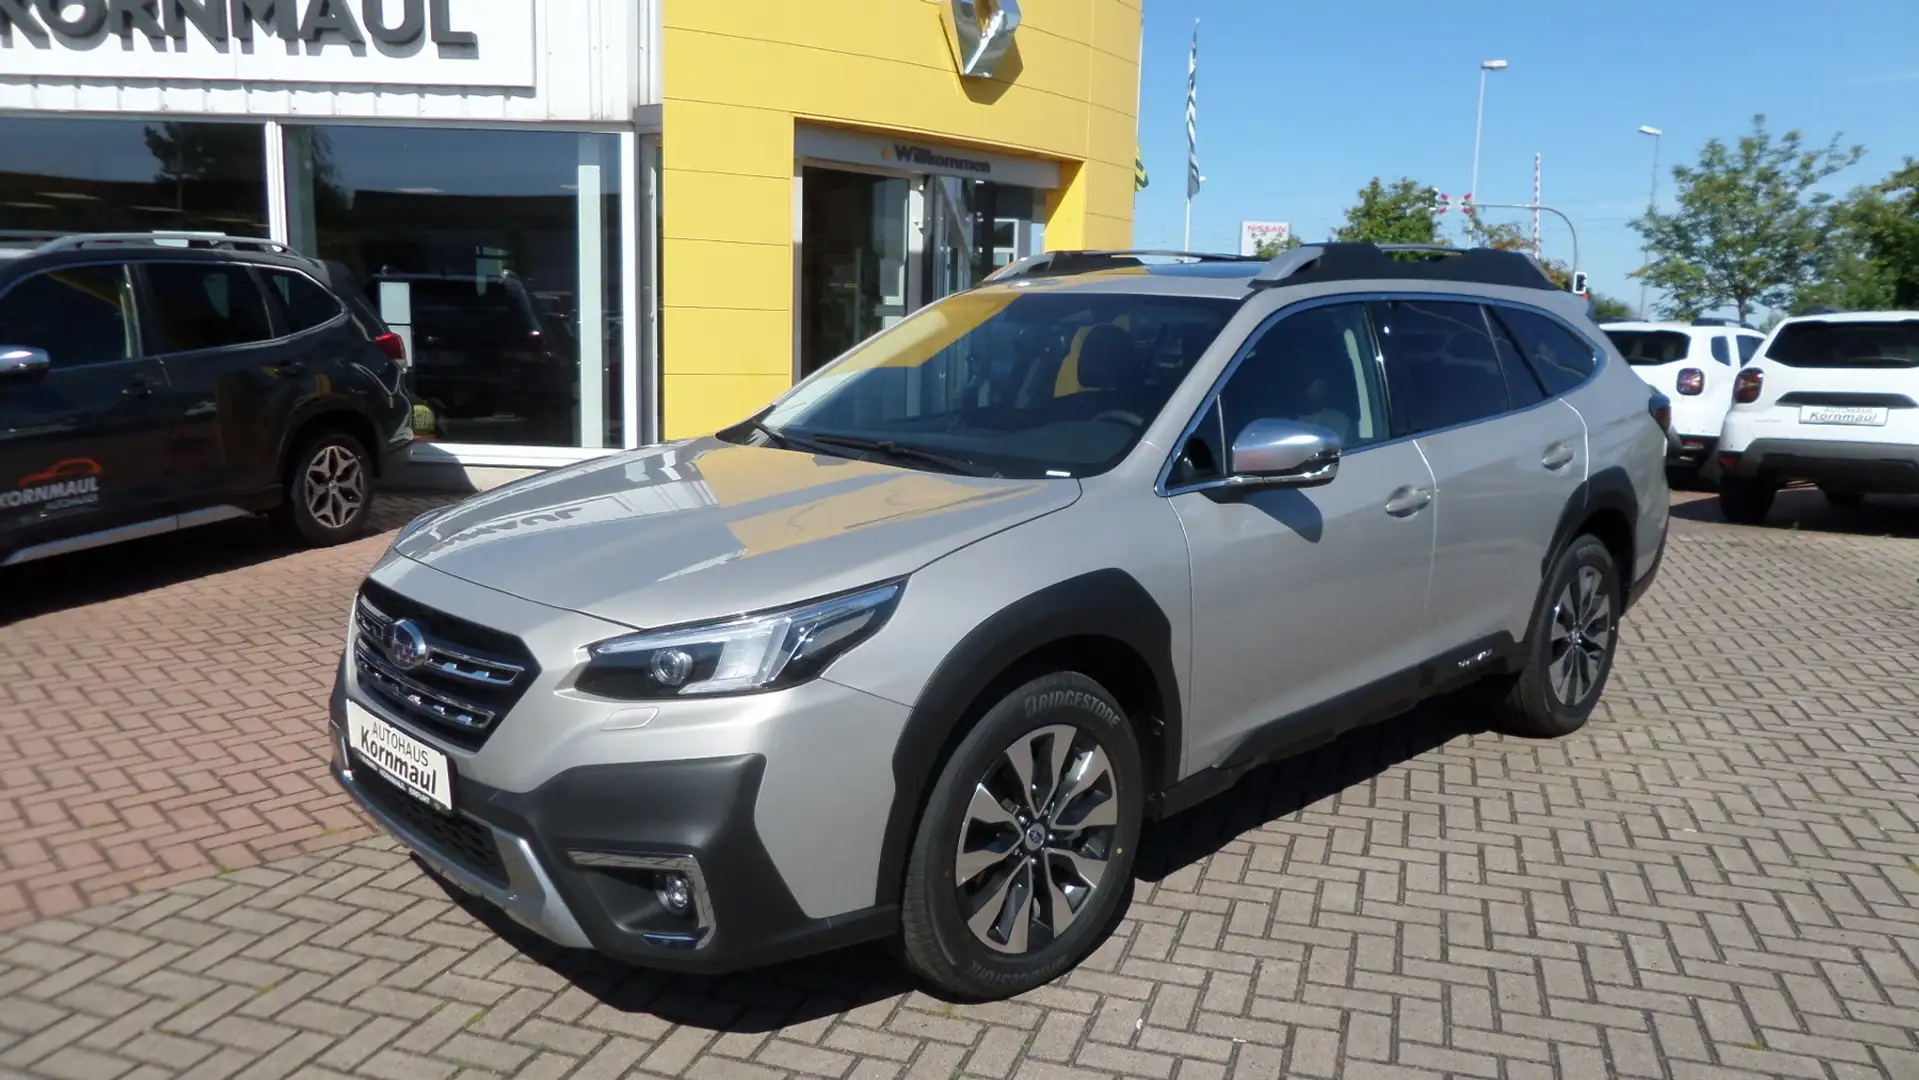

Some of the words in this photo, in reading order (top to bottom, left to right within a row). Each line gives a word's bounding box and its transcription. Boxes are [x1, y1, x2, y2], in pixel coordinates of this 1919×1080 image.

[893, 143, 991, 173] Willkommen
[1247, 224, 1286, 233] NISSAN
[1808, 411, 1878, 424] Kornmaul
[1024, 690, 1120, 729] BRIDGESTONE
[360, 725, 437, 796] Kornmaul
[372, 721, 429, 767] AUTOHAUS
